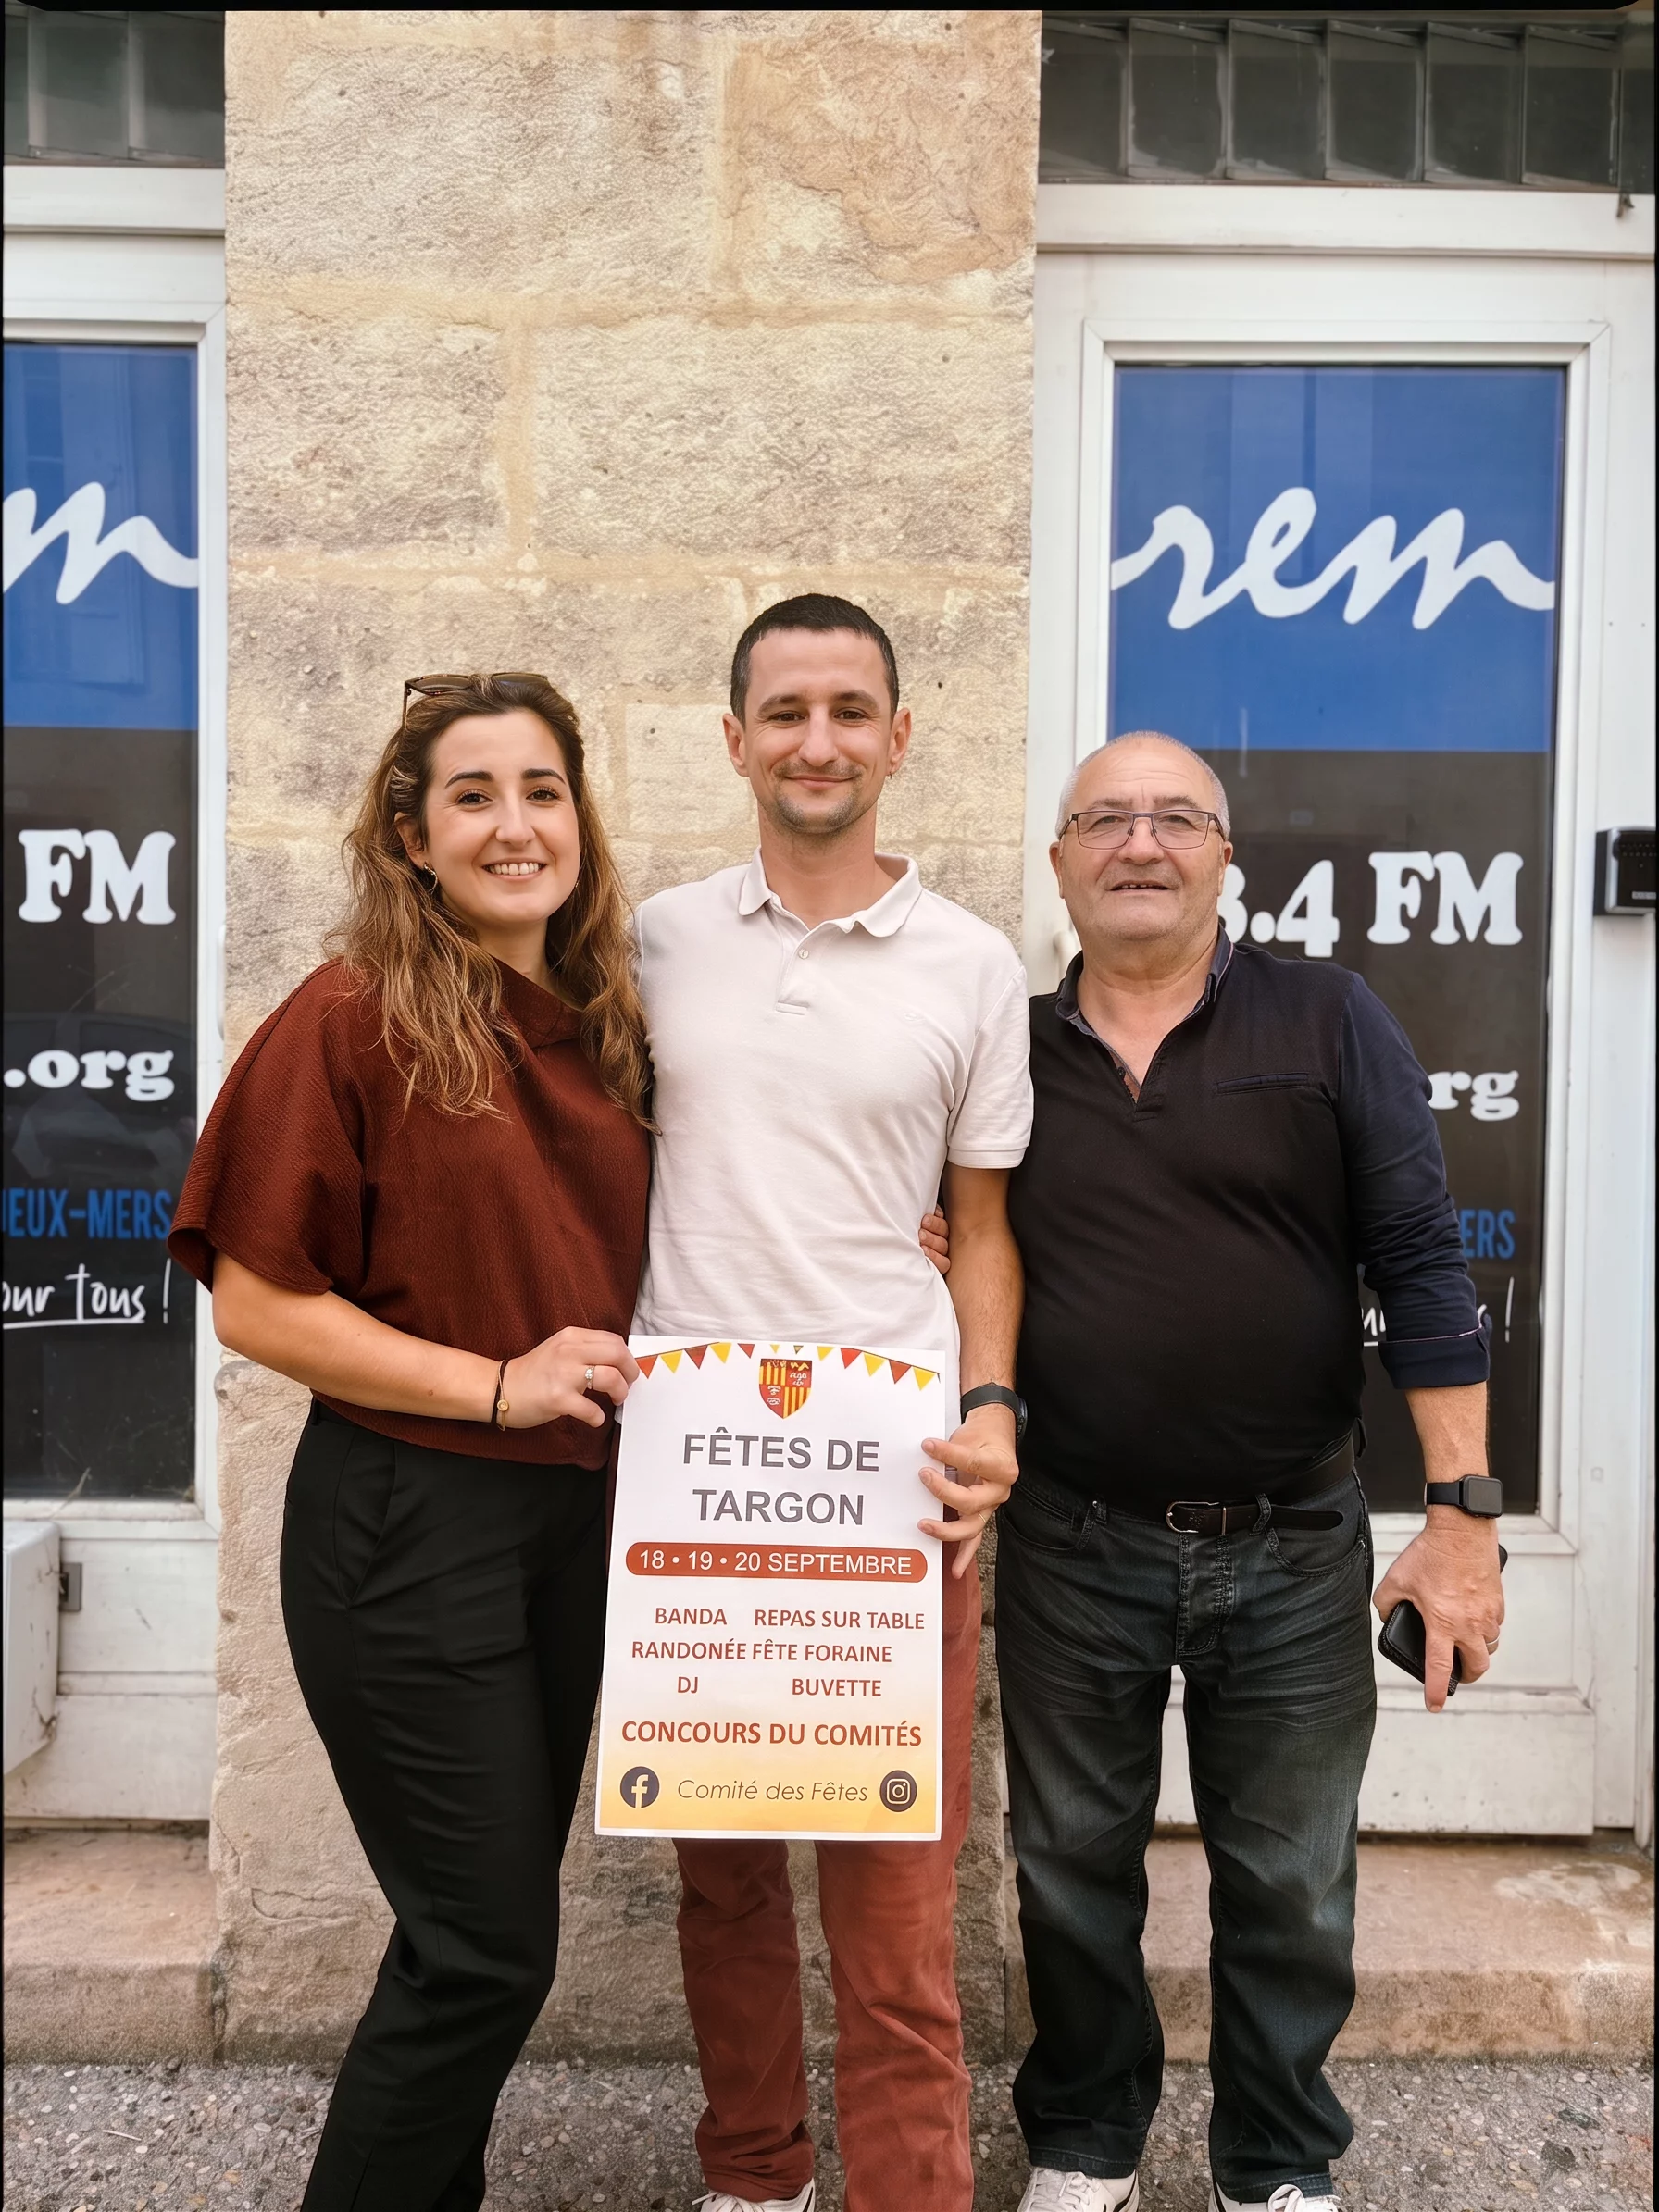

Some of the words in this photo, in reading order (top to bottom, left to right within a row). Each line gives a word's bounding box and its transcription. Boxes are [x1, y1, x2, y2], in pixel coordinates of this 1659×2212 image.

[18, 829, 177, 925] FM
[1367, 851, 1524, 946] FM
[3, 1187, 172, 1240] EUX-MERS
[65, 1263, 146, 1322] tous
[683, 1427, 811, 1468] FÊTES
[827, 1440, 879, 1473] DE
[692, 1489, 864, 1525] TARGON
[640, 1549, 665, 1571] 18
[688, 1551, 713, 1572] 19
[734, 1552, 762, 1572] 20
[768, 1553, 912, 1575] SEPTEMBRE
[655, 1608, 728, 1627] BANDA
[754, 1609, 817, 1628] REPAS
[821, 1610, 861, 1629] SUR
[867, 1612, 925, 1630] TABLE
[630, 1636, 747, 1659] RANDONÉE
[752, 1638, 798, 1660] FÊTE
[804, 1644, 892, 1662] FORAINE
[677, 1676, 699, 1695] DJ
[792, 1679, 882, 1696] BUVETTE
[621, 1720, 762, 1745] CONCOURS
[769, 1724, 805, 1745] DU
[814, 1720, 922, 1746] COMITÉS
[676, 1779, 761, 1800] Comité
[766, 1780, 804, 1801] des
[811, 1783, 867, 1803] Fêtes
